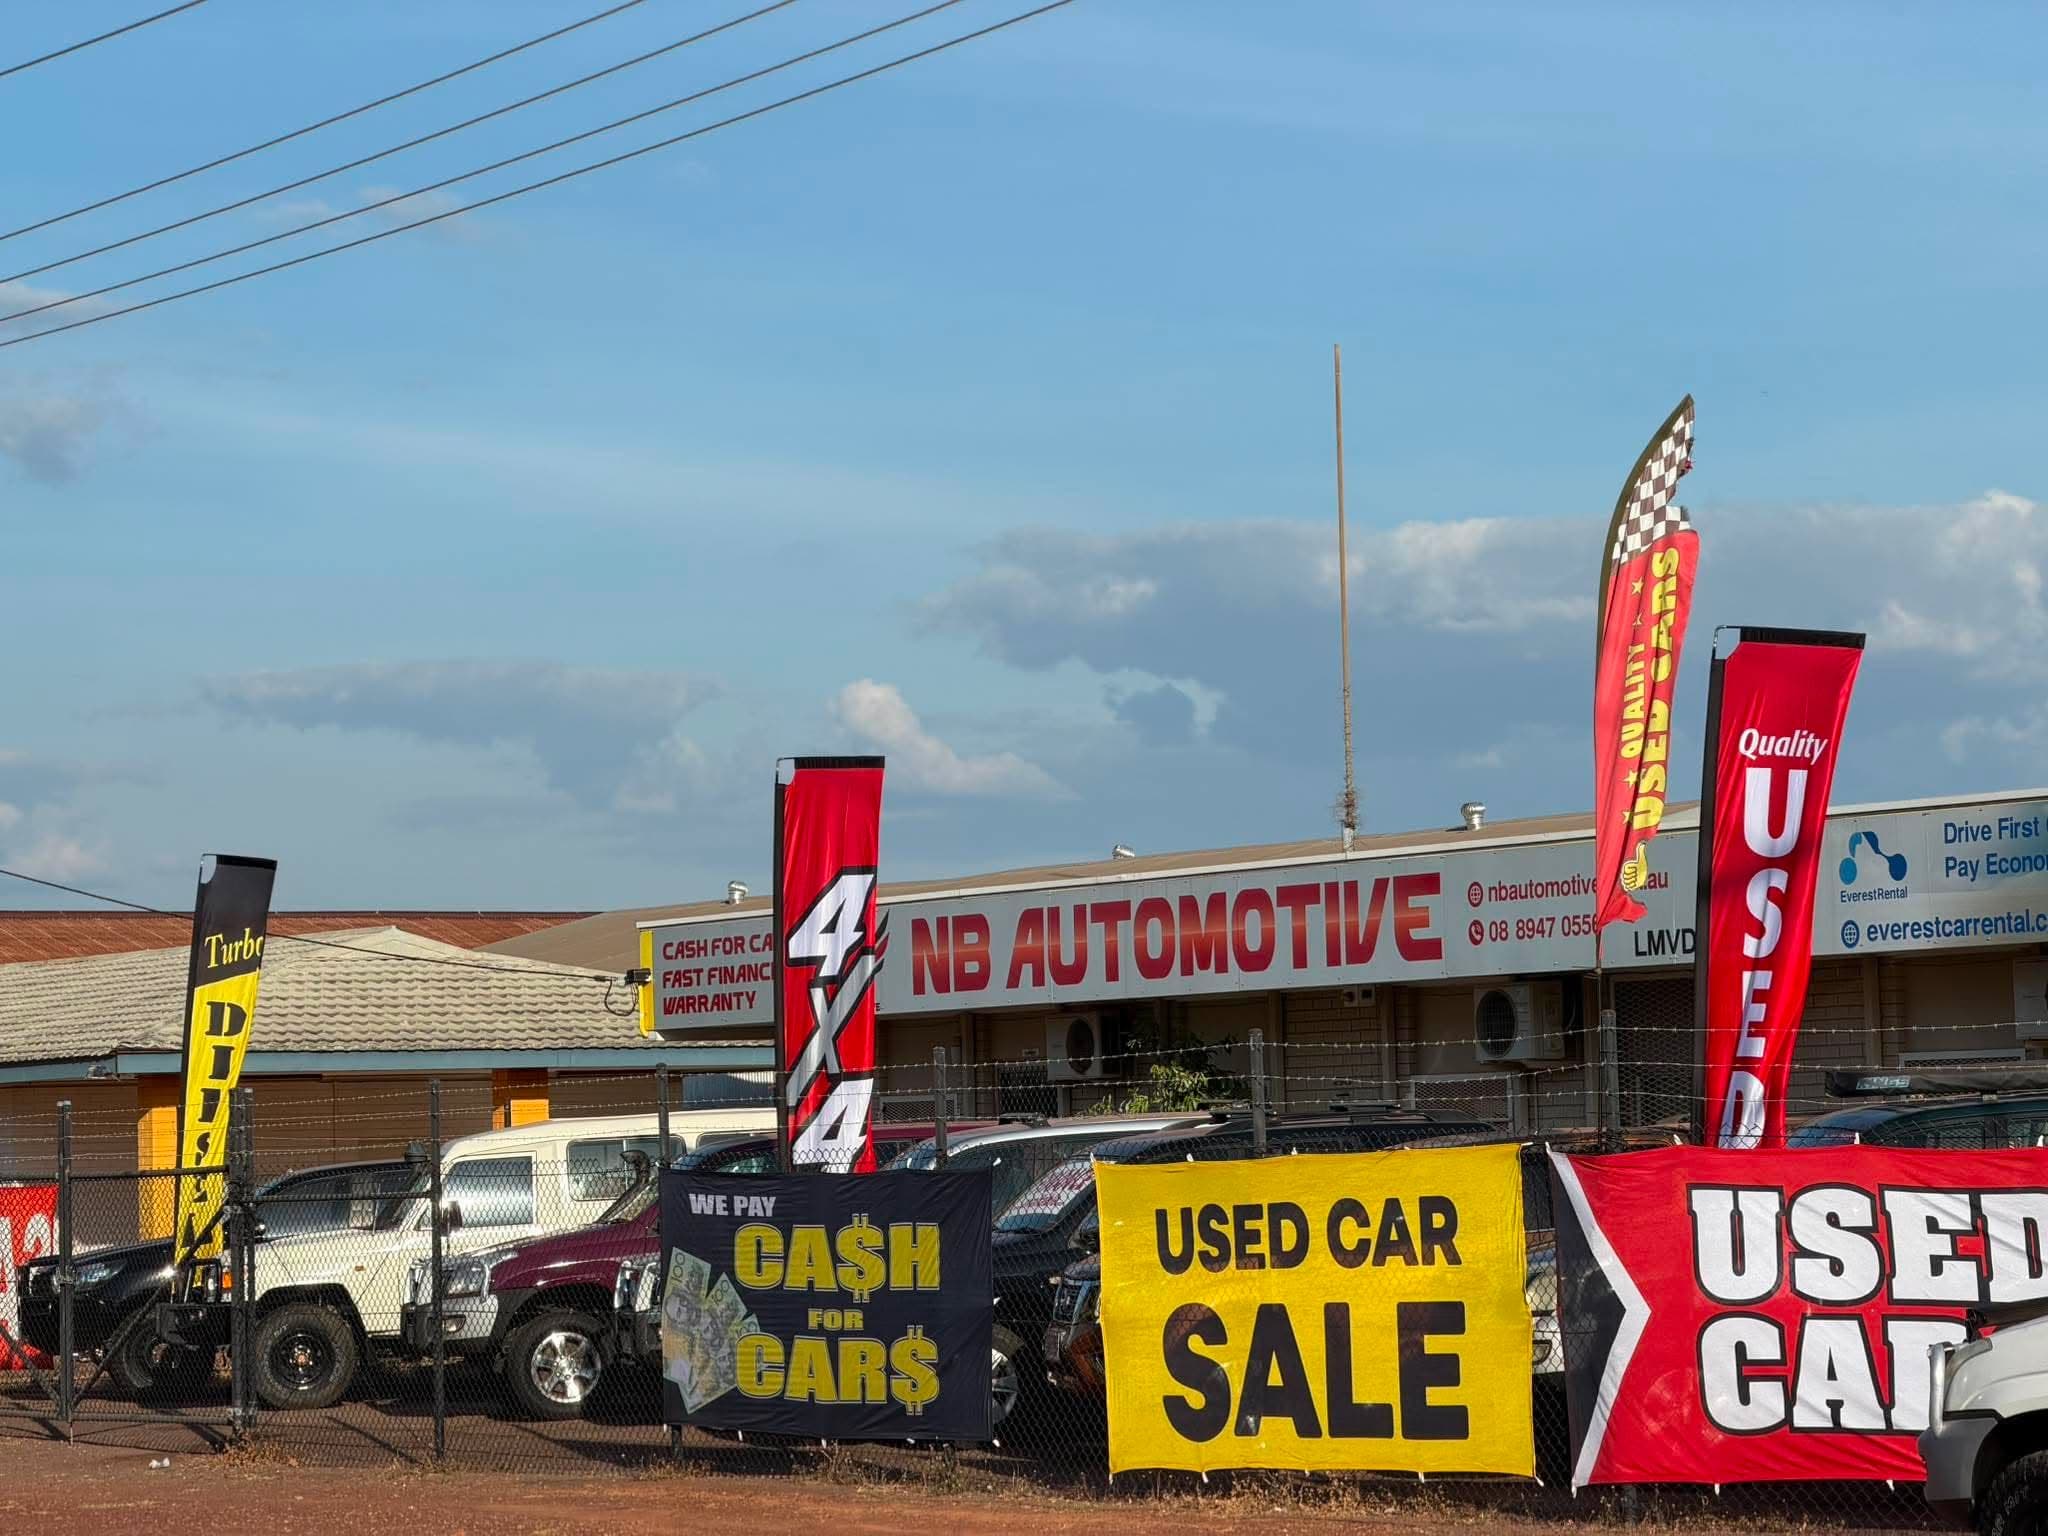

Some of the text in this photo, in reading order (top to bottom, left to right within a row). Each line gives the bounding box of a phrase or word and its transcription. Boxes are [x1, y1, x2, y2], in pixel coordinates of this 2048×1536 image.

[1620, 642, 1645, 759] QUALITY
[1632, 547, 1680, 831] USED CARS
[1738, 727, 1828, 765] Quality
[1944, 820, 1992, 844] Drive
[1998, 816, 2040, 841] First
[1945, 852, 2048, 882] Pay Econo
[1840, 886, 1908, 903] EverestRental
[911, 872, 1443, 996] NB AUTOMOTIVE
[1489, 920, 1508, 942] 08
[1516, 917, 1556, 940] 8947
[663, 939, 708, 960] CASH
[711, 935, 745, 957] FOR
[1718, 767, 1808, 1149] USED
[663, 967, 703, 989] FAST
[663, 990, 757, 1015] WARRANTY
[689, 1193, 776, 1217] WE PAY
[1156, 1195, 1461, 1275] USED CAR
[1686, 1182, 2048, 1306] USED
[808, 1308, 864, 1331] FOR
[1162, 1301, 1470, 1443] SALE
